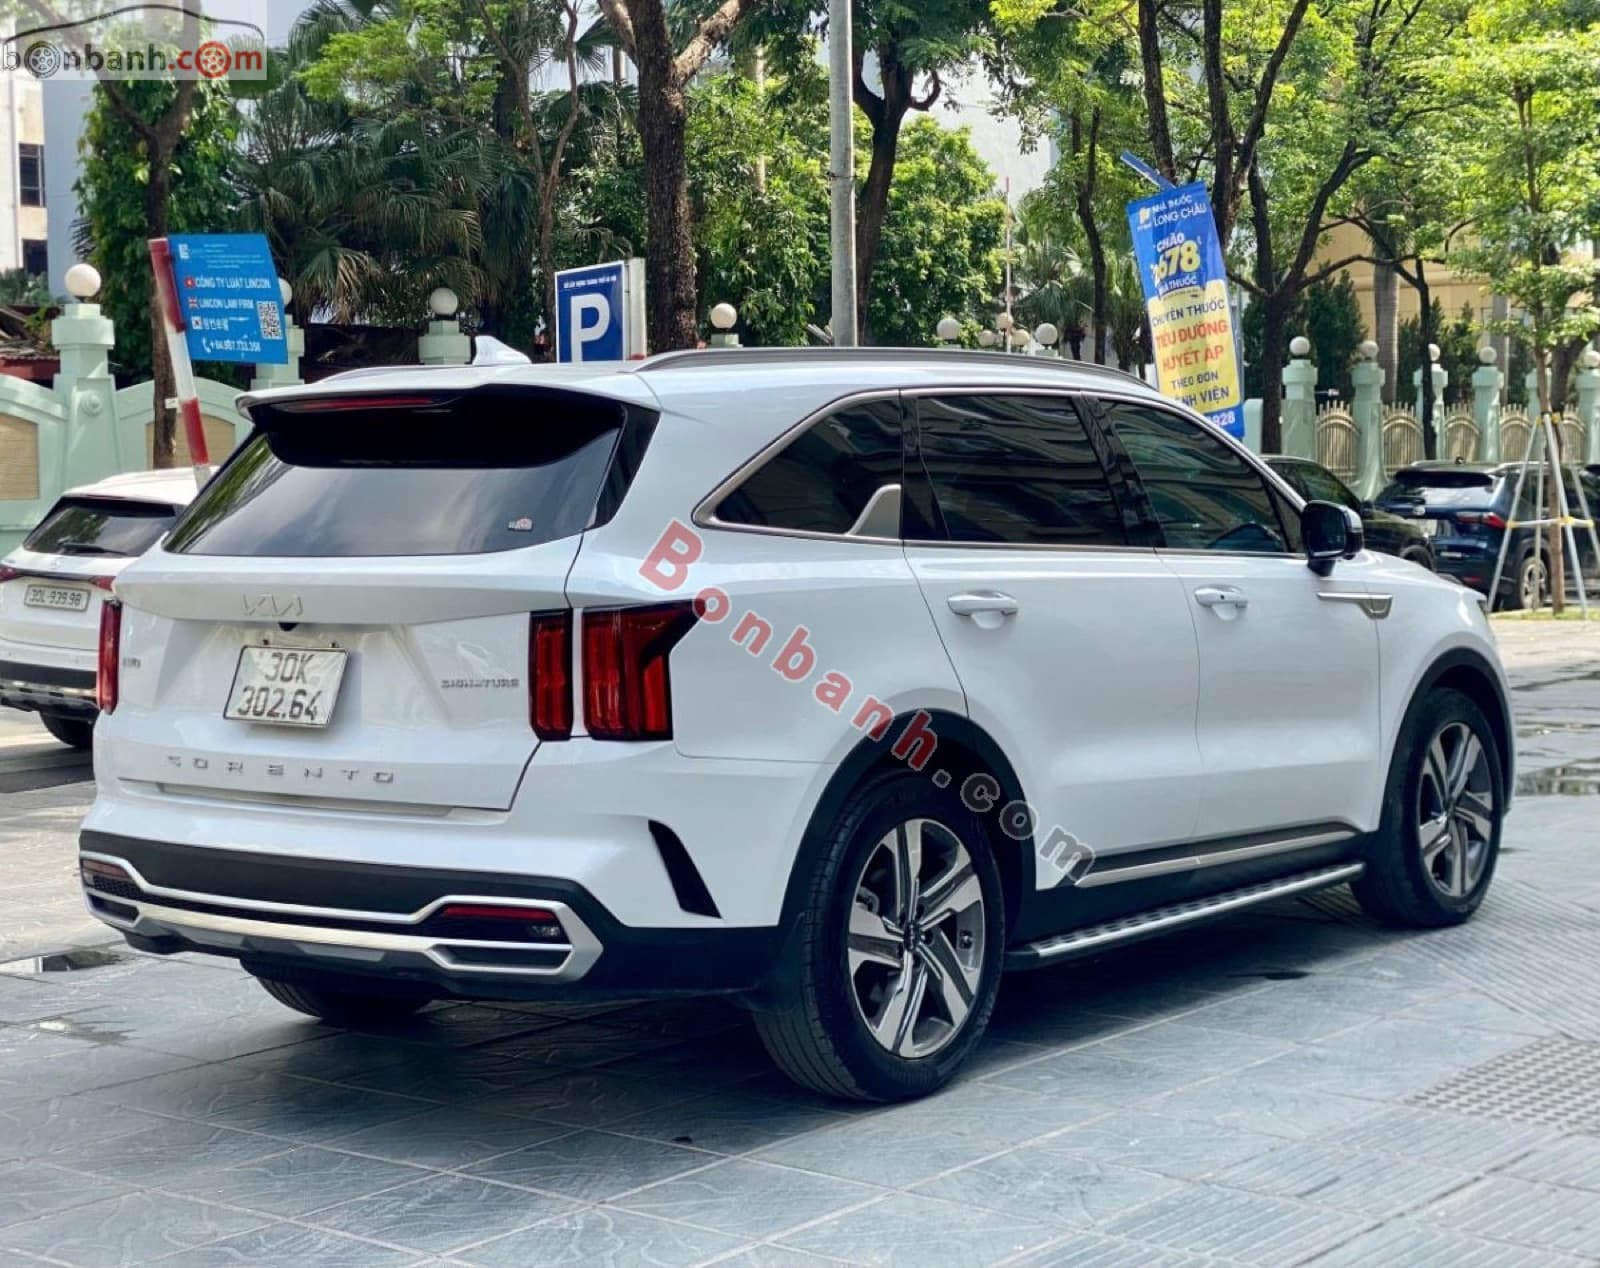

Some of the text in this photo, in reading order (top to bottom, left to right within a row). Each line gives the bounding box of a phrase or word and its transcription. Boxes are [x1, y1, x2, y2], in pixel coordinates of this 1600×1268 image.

[1153, 211, 1179, 227] LONG
[1186, 297, 1225, 317] THUỐC
[571, 293, 610, 362] P
[1171, 376, 1194, 391] THEO
[264, 652, 315, 684] 30K
[236, 686, 323, 721] 302.64
[167, 754, 395, 786] SORENTO
